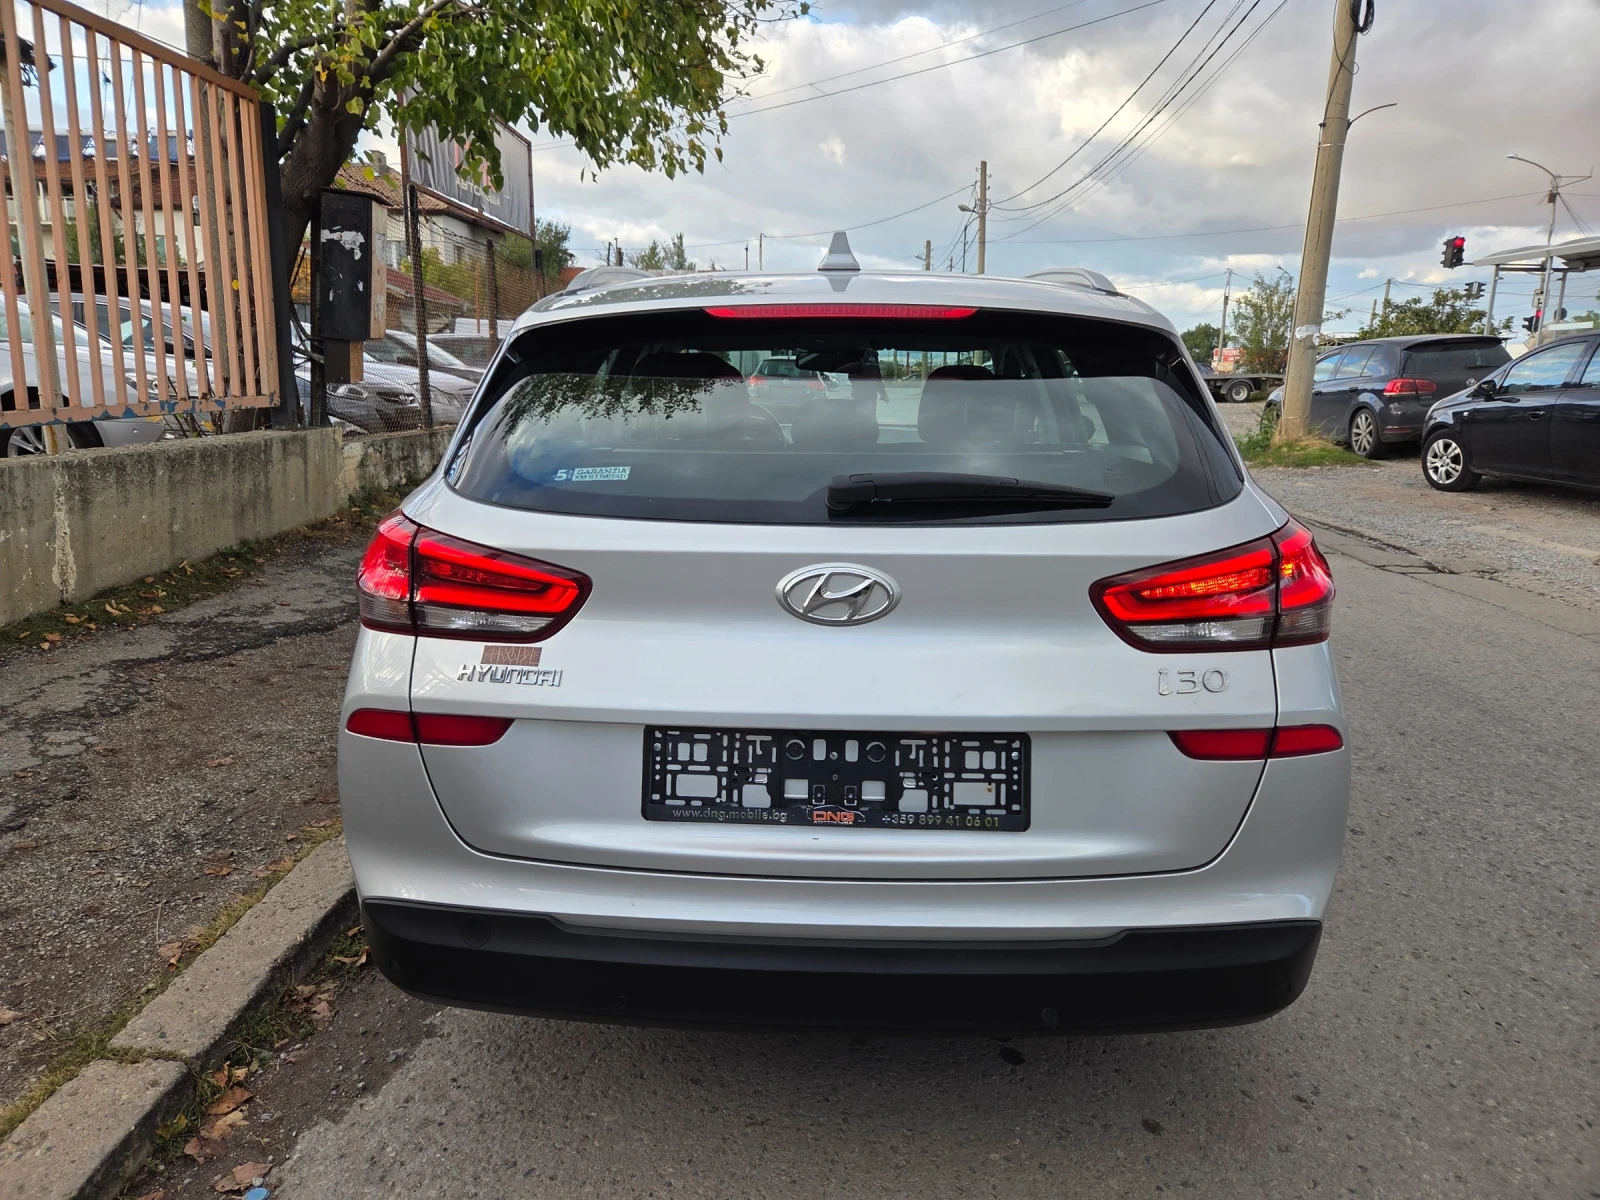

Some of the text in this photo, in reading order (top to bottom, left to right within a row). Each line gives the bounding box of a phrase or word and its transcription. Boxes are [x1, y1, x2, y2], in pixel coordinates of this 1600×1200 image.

[555, 469, 568, 481] 5
[576, 467, 627, 475] GARANZIA
[457, 664, 563, 687] HYUNDAI
[1158, 667, 1228, 696] i30
[672, 808, 788, 823] www.dng.mobile.bg
[813, 810, 855, 821] DNG
[882, 813, 999, 827] +359 899 41 06 01
